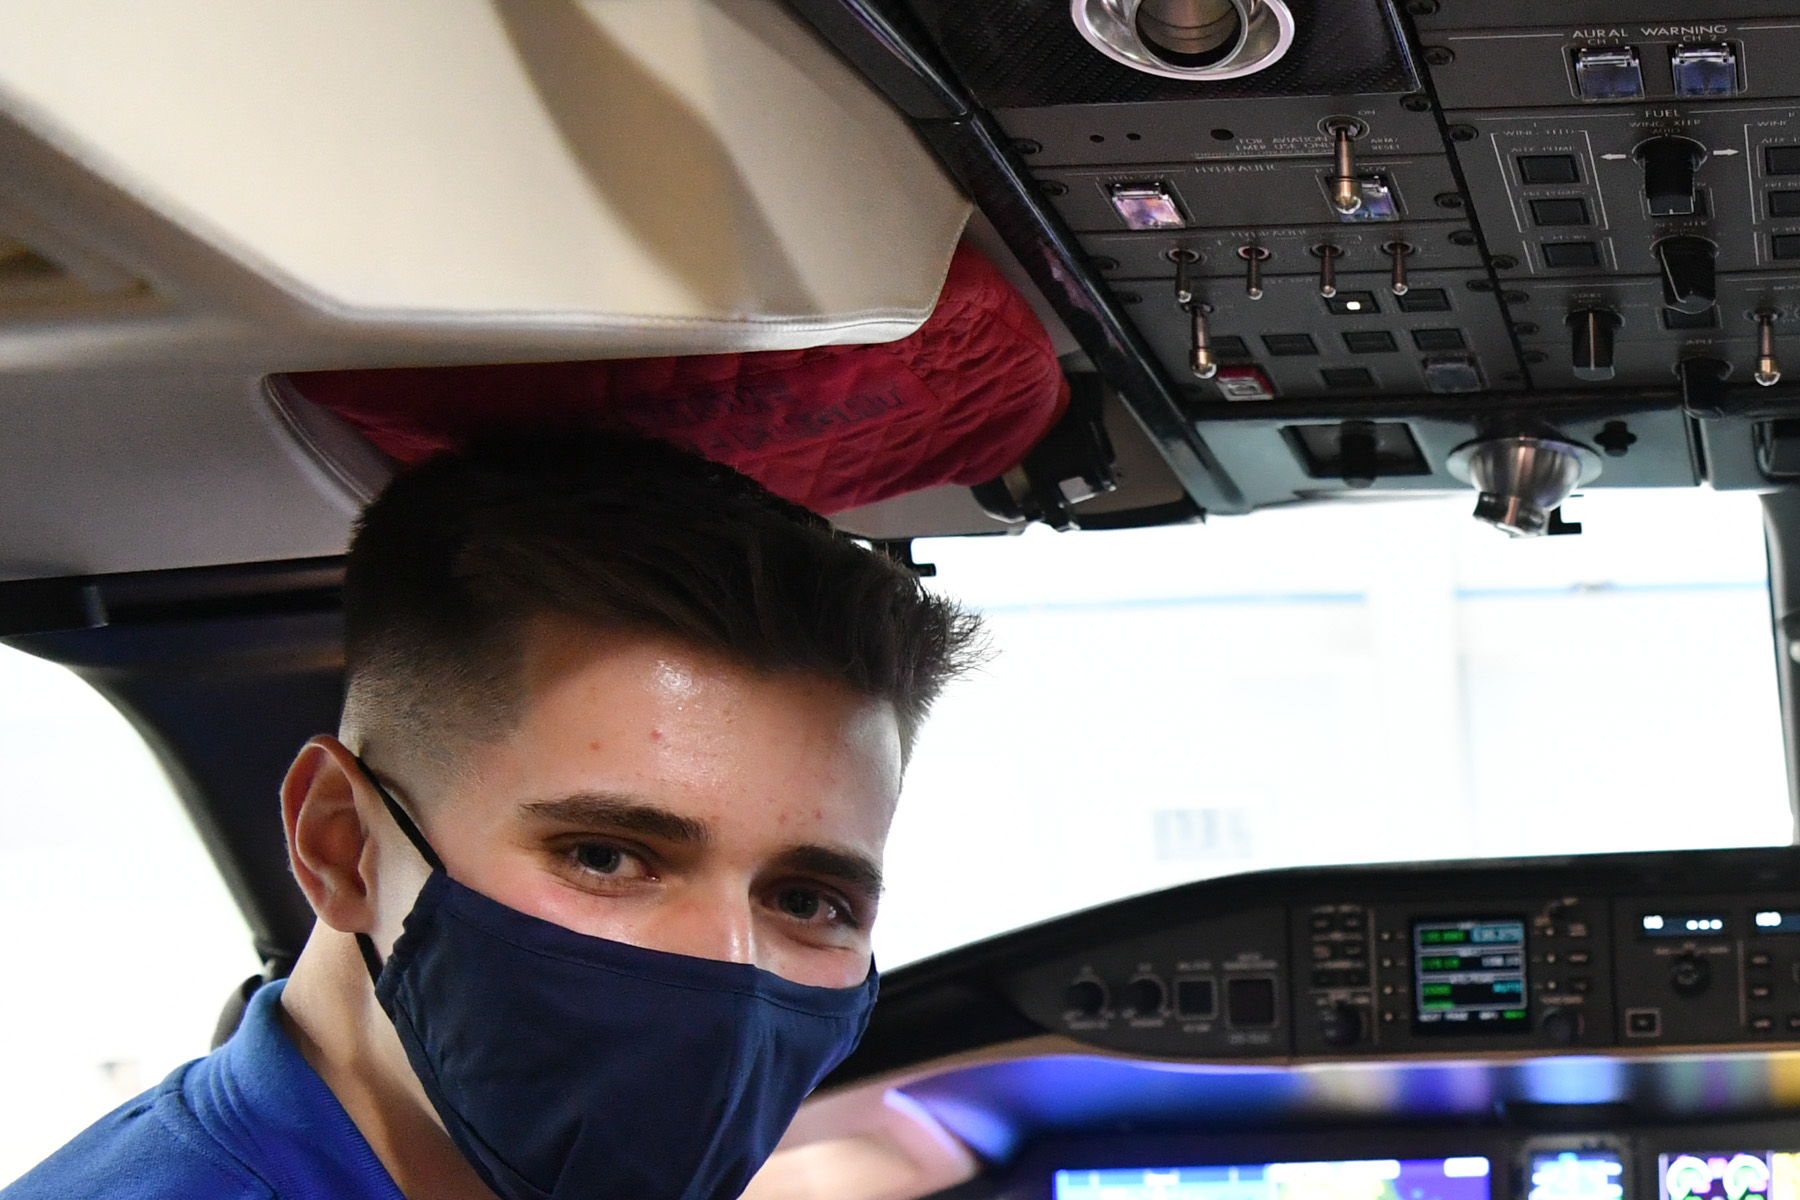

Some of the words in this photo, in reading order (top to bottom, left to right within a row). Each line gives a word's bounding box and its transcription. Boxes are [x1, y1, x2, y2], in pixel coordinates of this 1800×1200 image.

[1572, 28, 1629, 39] AURAL
[1640, 25, 1728, 35] WARNING
[1645, 110, 1680, 118] FUEL
